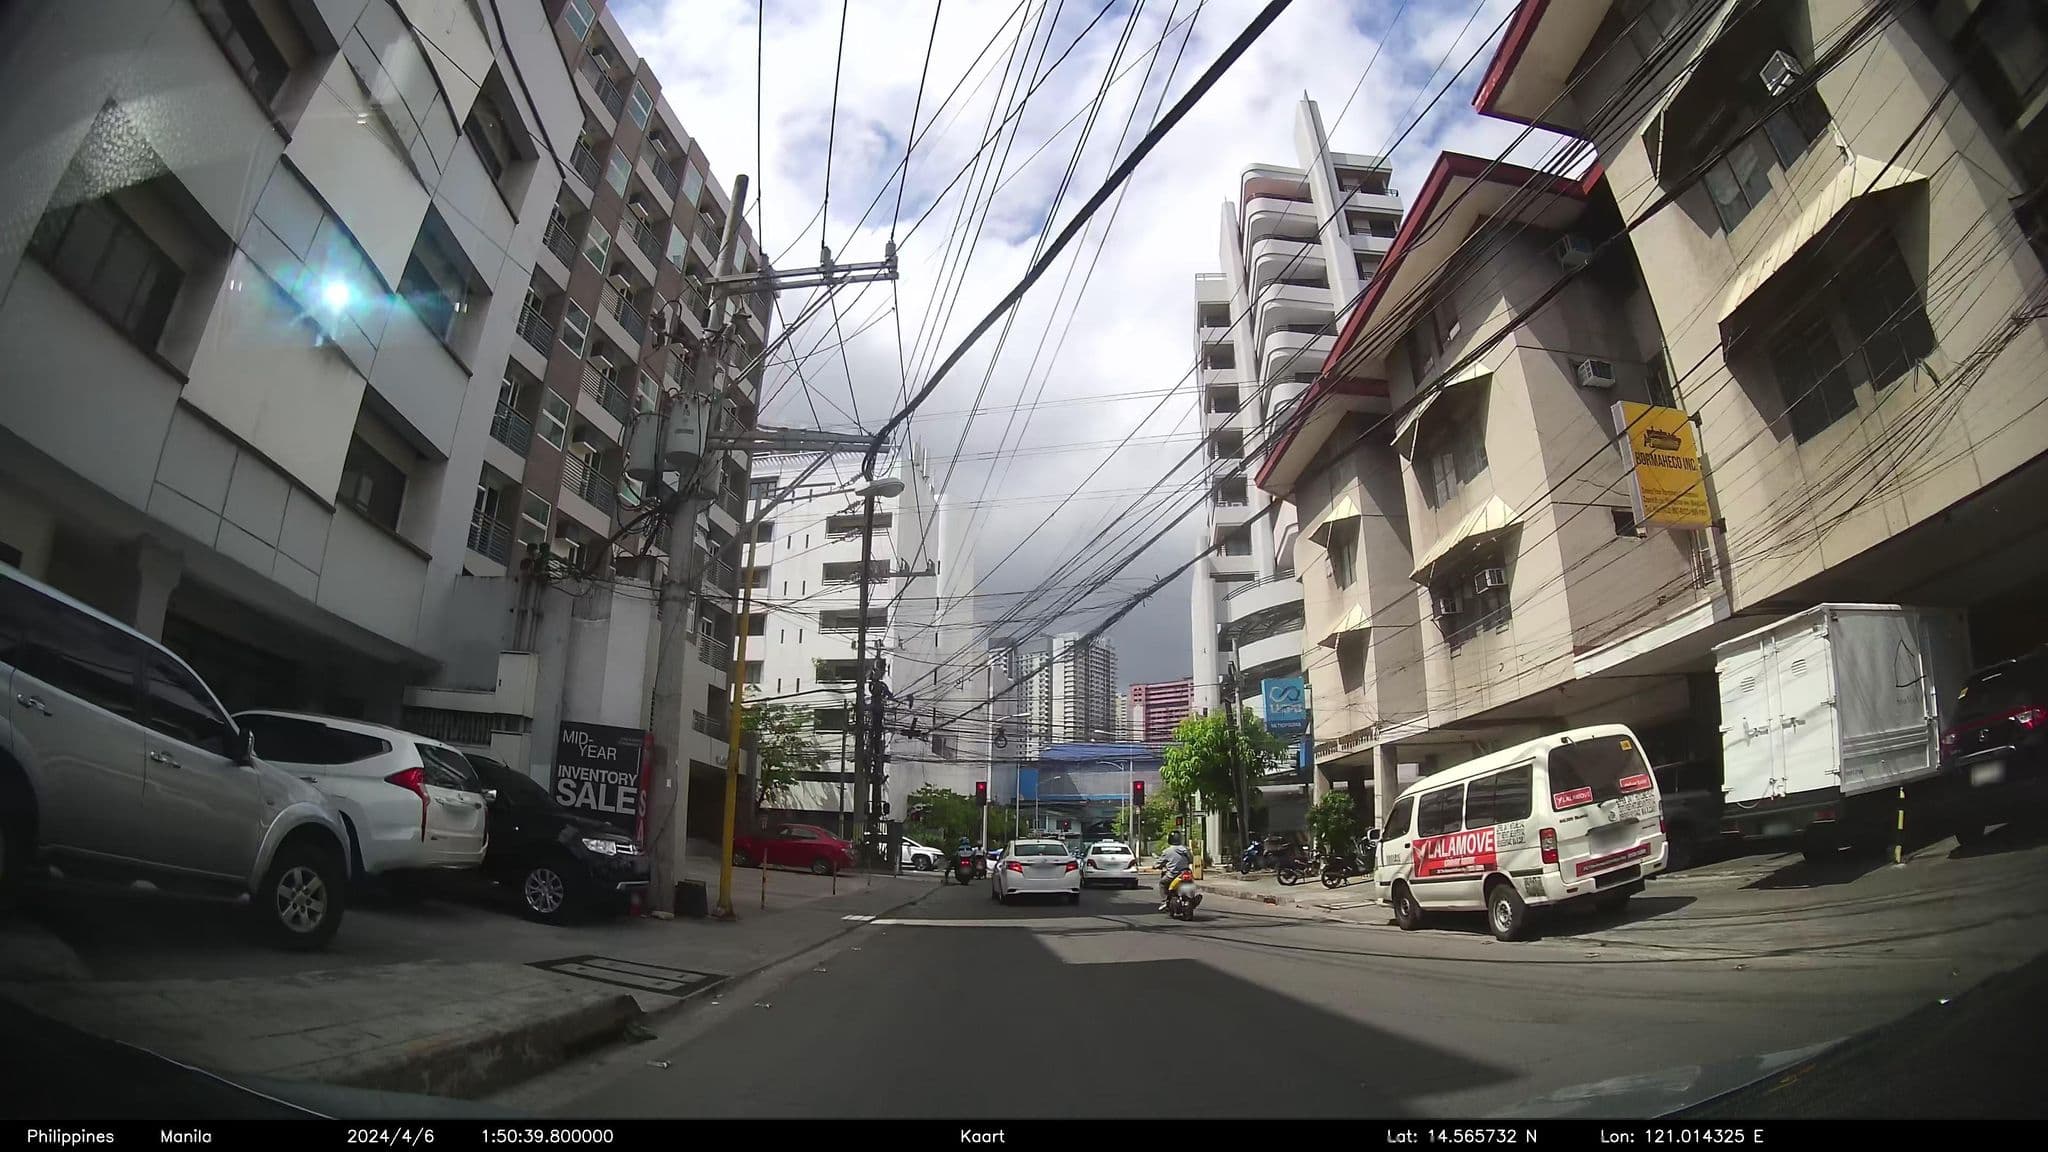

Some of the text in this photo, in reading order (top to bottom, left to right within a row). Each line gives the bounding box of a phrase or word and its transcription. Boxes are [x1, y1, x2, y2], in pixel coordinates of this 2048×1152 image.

[1634, 452, 1698, 471] BORMAHECO INC.
[562, 729, 594, 744] MID-
[579, 743, 617, 761] YEAR
[558, 765, 638, 786] INVENTORY
[556, 778, 638, 815] SALE
[1428, 831, 1494, 859] LALAMOVE
